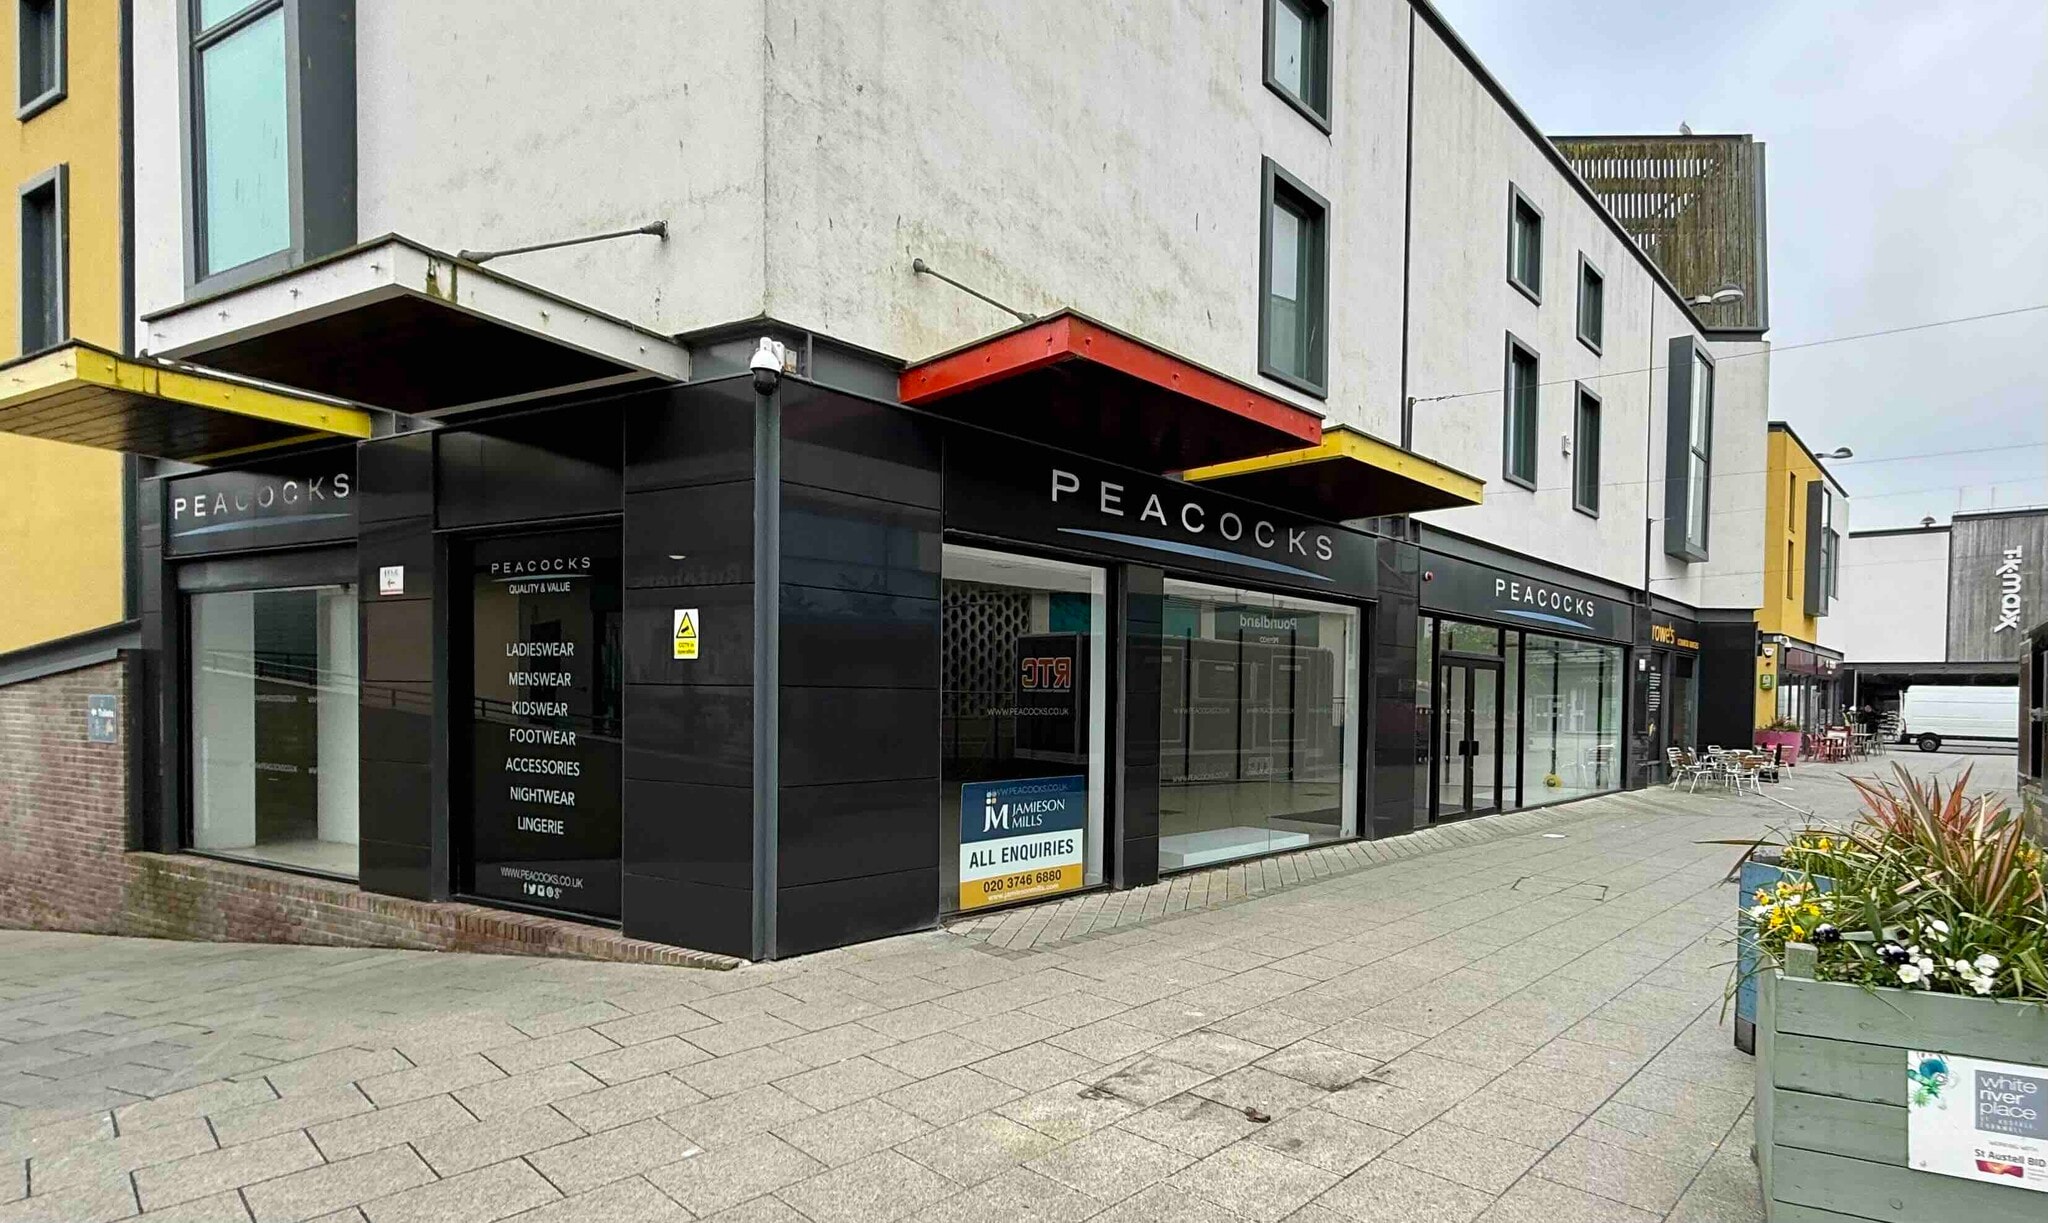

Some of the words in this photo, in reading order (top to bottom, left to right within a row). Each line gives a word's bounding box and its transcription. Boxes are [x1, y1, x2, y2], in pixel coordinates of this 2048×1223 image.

[174, 473, 350, 520] PEACOCKS
[1052, 468, 1333, 561] PEACOCKS
[491, 557, 591, 574] PEACOCKS
[509, 583, 539, 595] QUALITY
[540, 583, 546, 593] &
[547, 581, 571, 592] VALUE
[1495, 578, 1595, 618] PEACOCKS
[506, 642, 574, 657] LADIESWEAR
[508, 672, 571, 687] MENSWEAR
[511, 701, 568, 717] KIDSWEAR
[509, 728, 576, 746] FOOTWEAR
[505, 757, 580, 776] ACCESSORIES
[510, 786, 575, 806] NIGHTWEAR
[1012, 799, 1065, 817] JAMIESON
[517, 816, 564, 835] LINGERIE
[1012, 814, 1042, 828] MILLS
[969, 849, 996, 869] ALL
[1001, 838, 1074, 863] ENQUIRIES
[500, 866, 583, 889] WWW.PEACOCKS.CO.UK
[983, 879, 1003, 893] 020
[1007, 874, 1032, 889] 3746
[1036, 869, 1062, 883] 6880
[1980, 1076, 2037, 1094] white
[1980, 1088, 2024, 1105] river
[1980, 1102, 2037, 1120] place
[1975, 1149, 1985, 1157] St
[1988, 1151, 2025, 1164] Austell
[2028, 1157, 2046, 1167] BID
